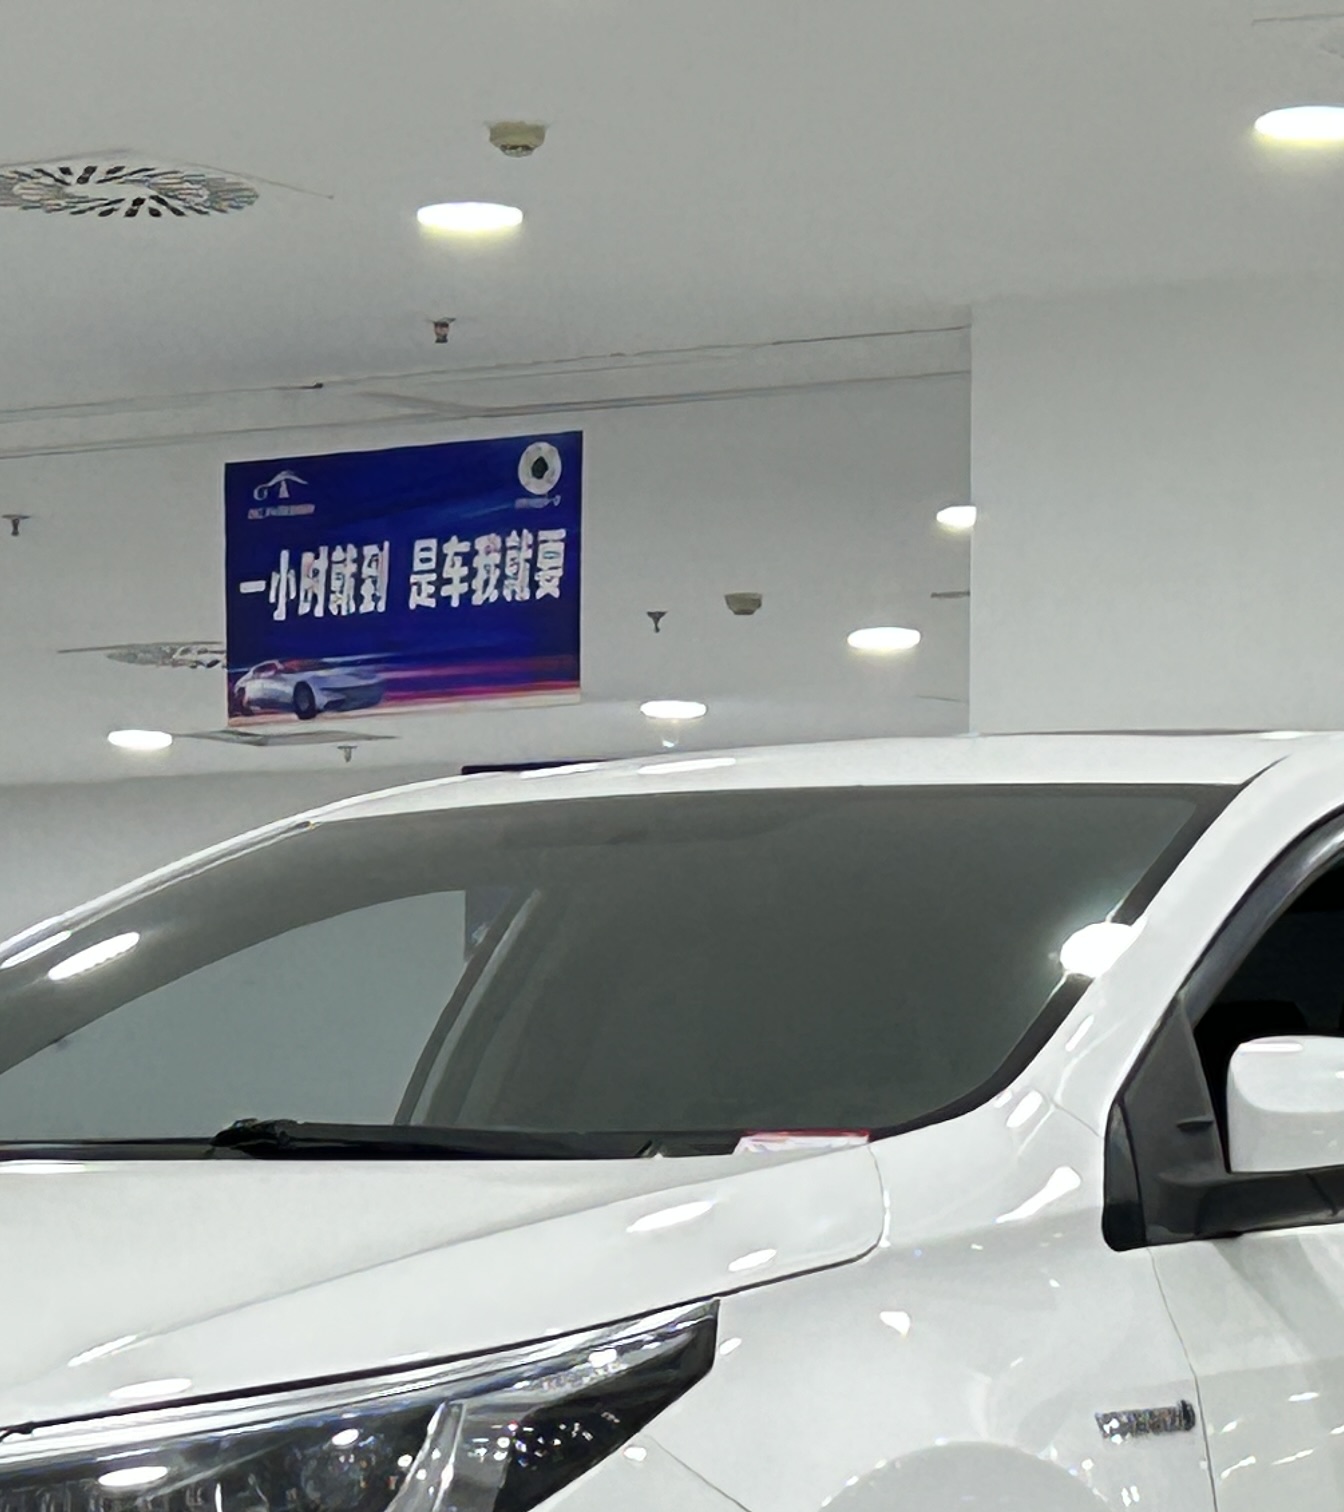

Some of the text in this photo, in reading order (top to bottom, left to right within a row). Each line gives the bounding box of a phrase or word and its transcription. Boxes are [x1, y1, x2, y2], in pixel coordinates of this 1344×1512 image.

[239, 528, 567, 621] 一小时就到 是车我就要
